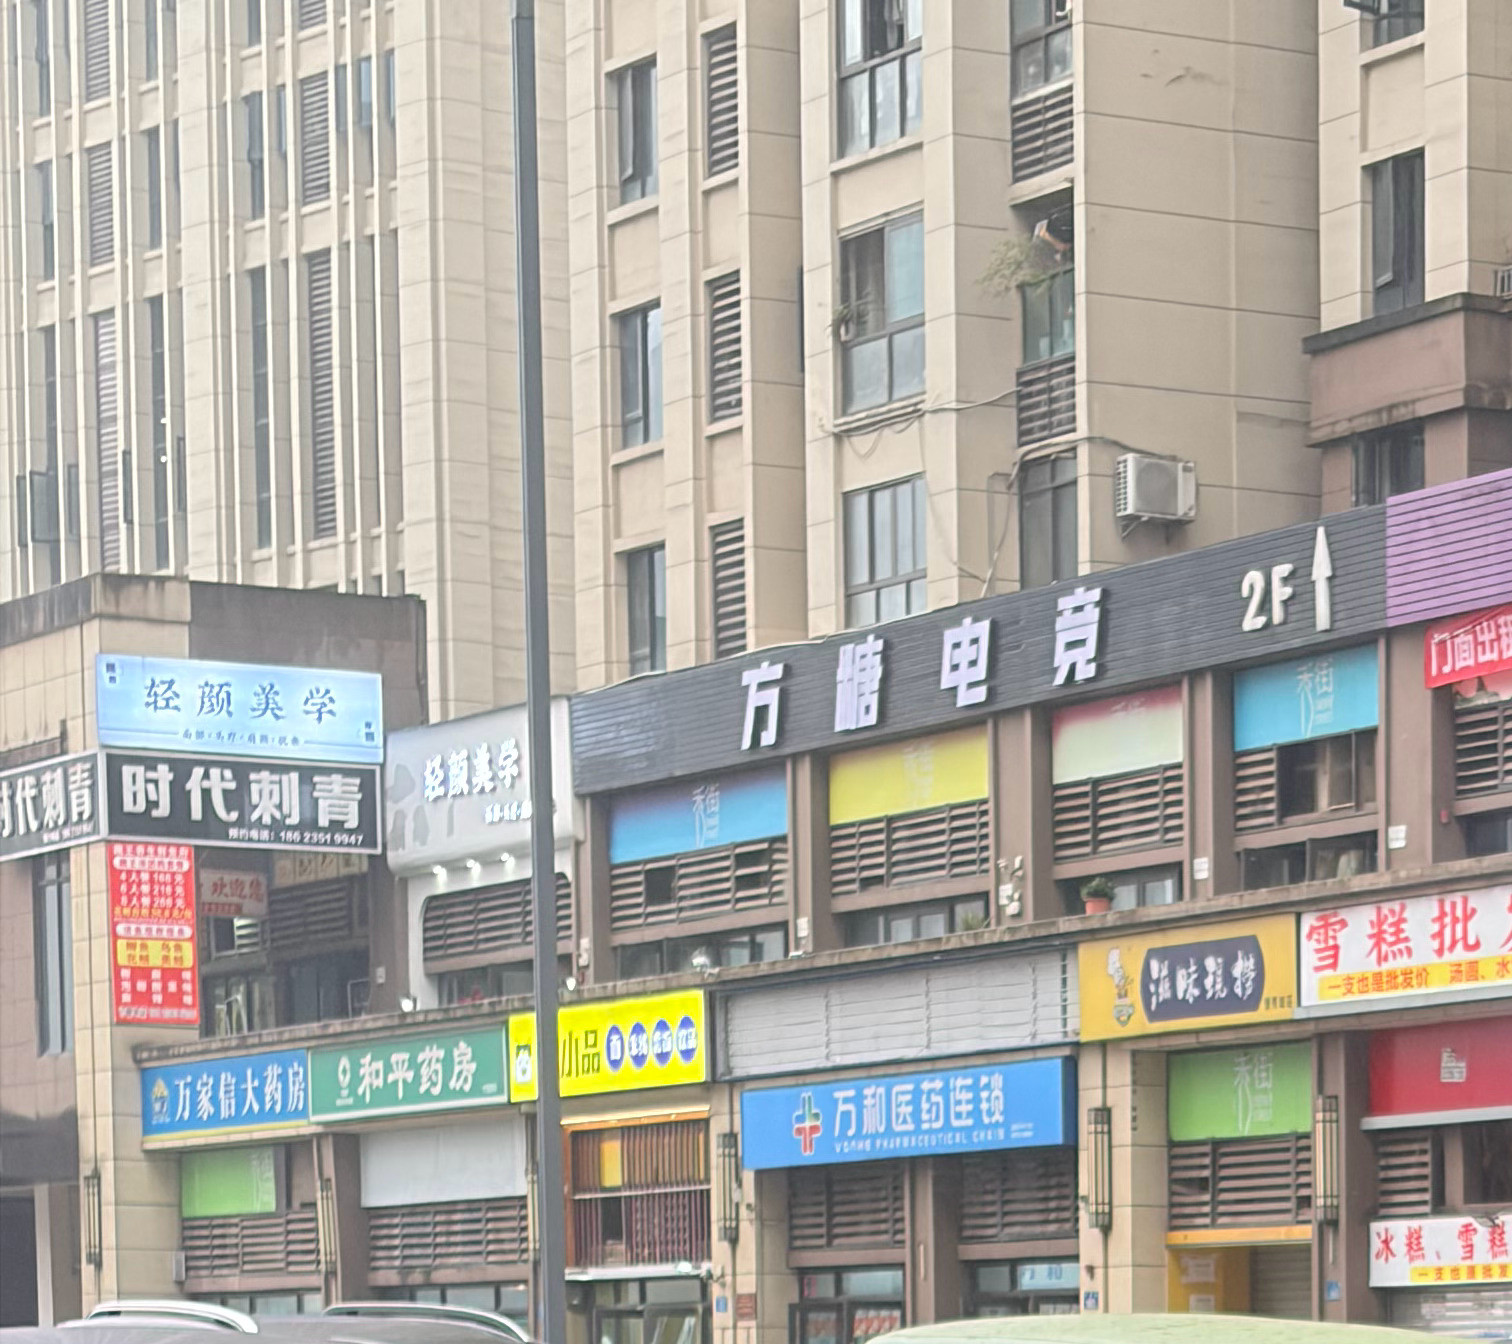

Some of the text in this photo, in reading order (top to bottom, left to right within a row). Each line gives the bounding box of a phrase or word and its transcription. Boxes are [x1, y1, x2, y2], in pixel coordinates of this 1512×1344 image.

[1242, 563, 1294, 632] 2F
[144, 677, 336, 724] 轻颜美学
[741, 586, 1103, 750] 方糖电竞
[121, 764, 363, 829] 时代刺青
[424, 737, 519, 802] 轻颜美学
[357, 1040, 477, 1103] 和平药房
[833, 1072, 1004, 1137] 万和医药连锁
